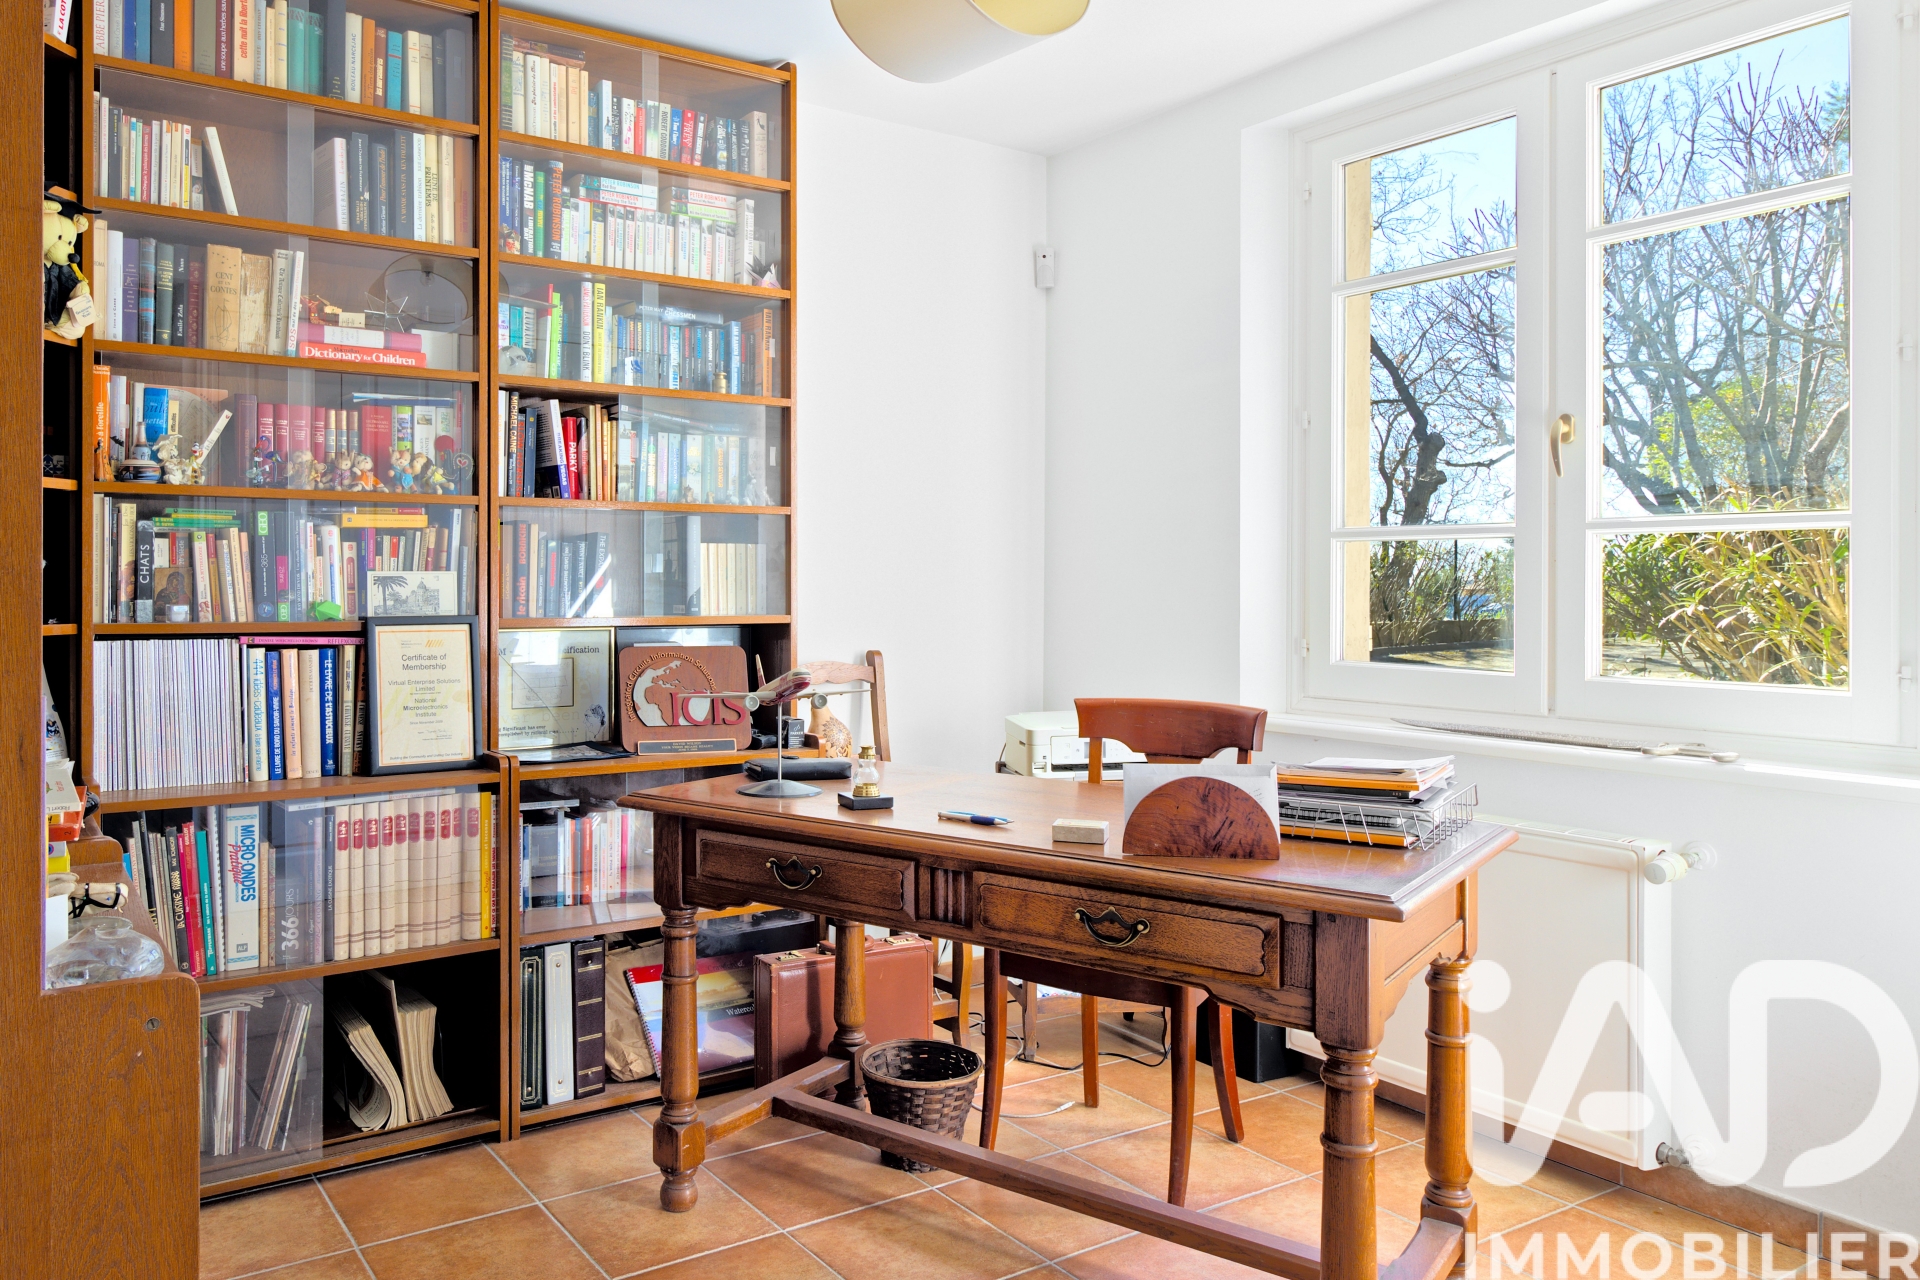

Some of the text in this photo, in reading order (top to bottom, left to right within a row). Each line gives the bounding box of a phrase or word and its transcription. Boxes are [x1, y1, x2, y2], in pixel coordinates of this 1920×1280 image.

[58, 17, 65, 30] LA
[219, 13, 227, 31] herbes
[239, 26, 248, 40] nuit
[220, 43, 228, 60] soupe
[239, 41, 248, 58] cette
[659, 110, 669, 159] ROBERT GODDARD
[671, 121, 680, 145] Tom Clancy
[682, 122, 690, 143] FREY
[524, 171, 534, 209] McNAB
[601, 177, 640, 190] PETER ROBINSON
[551, 168, 562, 241] PETER ROBINSON
[600, 190, 639, 202] PETER ROBINSON
[689, 191, 727, 203] PETER ROBINSON
[339, 204, 347, 225] HERVÉ
[400, 215, 407, 223] UN
[215, 271, 234, 281] CENT
[210, 285, 237, 295] CONTES
[582, 286, 590, 327] JAMES PATTERSON
[596, 287, 604, 330] IAN RANKIN
[664, 310, 696, 320] CHESSMEN
[289, 328, 297, 349] SOS
[525, 311, 535, 347] LUDLUM
[305, 346, 364, 362] Dictionary
[372, 352, 416, 366] Children
[582, 331, 590, 371] DON'T BLINK
[96, 401, 104, 430] l'oreille
[509, 395, 518, 454] MICHAEL CAINE
[515, 421, 525, 492] SLOW HORSES
[556, 432, 568, 486] BREAKING VEGAS
[568, 441, 578, 473] PARKY
[258, 512, 268, 534] GEO
[519, 523, 527, 564] BORNICHE
[599, 535, 607, 548] THE
[140, 544, 150, 584] CHATS
[516, 576, 526, 615] le ricain
[401, 653, 447, 662] Certificate of
[563, 645, 600, 654] cification
[253, 658, 264, 676] 444
[402, 663, 447, 671] Membership
[624, 652, 717, 723] Integrated Circuits Information Solutions
[272, 696, 280, 727] SAVOIR-VIVRE
[325, 659, 334, 744] LE LIVRE DE L'ASTUCIEUX
[670, 690, 747, 727] ICIS
[228, 844, 243, 885] Pratique
[174, 891, 185, 929] LA CUISINE
[281, 888, 299, 951] 366 JOURS
